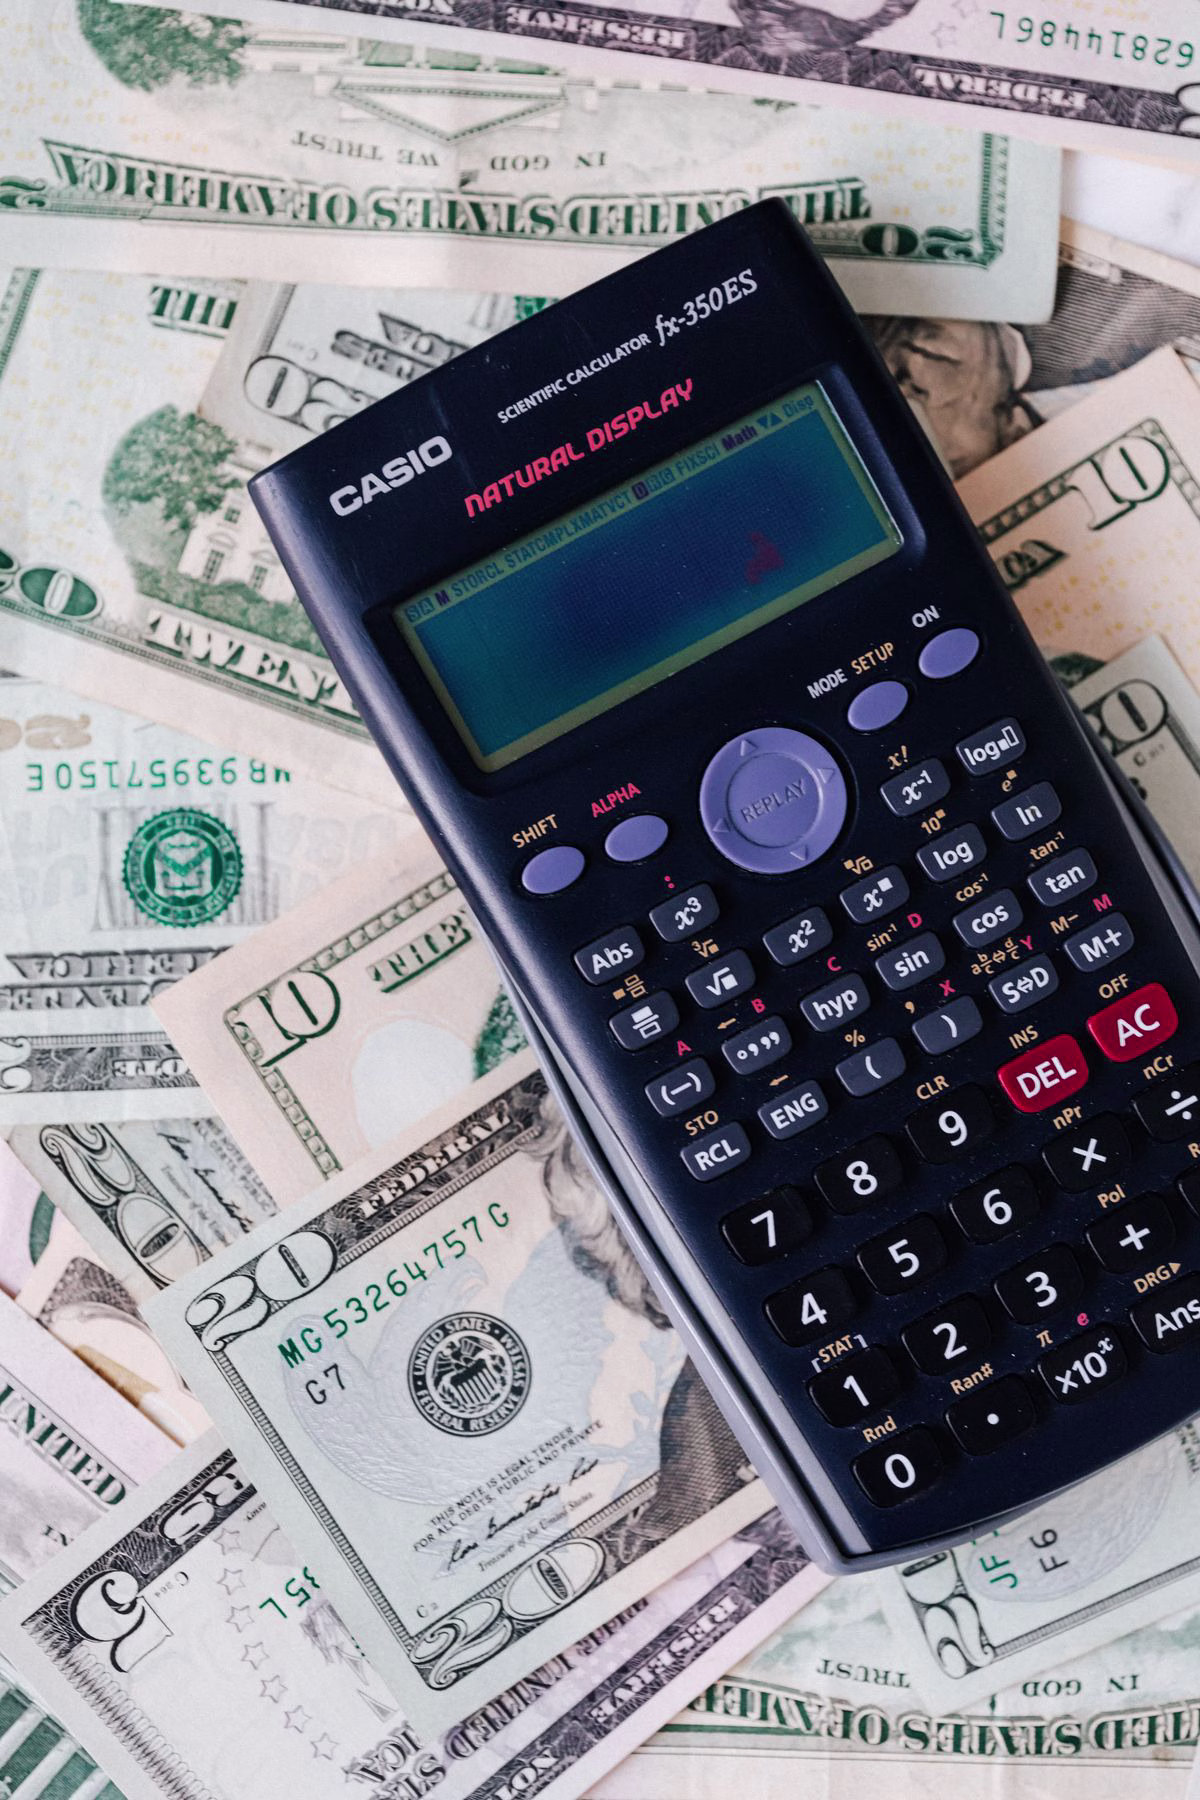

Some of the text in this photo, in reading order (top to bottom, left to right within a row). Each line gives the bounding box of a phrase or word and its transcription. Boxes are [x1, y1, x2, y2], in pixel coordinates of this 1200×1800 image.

[505, 5, 1088, 111] FEDERAL RESERVE
[290, 129, 607, 172] IN GOD WE TRUST
[40, 138, 755, 237] NITED STATES OF AMERICA
[497, 268, 759, 424] SCIENTIFIC CALCULATOR fx-350ES
[720, 424, 759, 452] Math
[781, 393, 815, 419] Disp
[463, 378, 694, 519] NATURAL DISPLAY
[329, 435, 453, 517] CASIO
[1066, 435, 1171, 532] 10
[911, 604, 941, 628] ON
[143, 608, 366, 722] TWENT
[807, 667, 848, 700] MODE
[590, 782, 642, 818] ALPHA
[739, 779, 809, 824] REPLAY
[511, 813, 559, 849] SHIFT
[932, 841, 975, 870] log
[1045, 865, 1087, 894] tan
[906, 913, 923, 929] D
[971, 904, 1010, 934] cos
[1092, 893, 1113, 913] M
[366, 905, 474, 994] THE
[591, 941, 634, 975] Abs
[1018, 935, 1034, 951] Y
[1079, 928, 1123, 963] M+
[826, 956, 843, 972] C
[894, 949, 931, 978] sin
[812, 988, 859, 1021] hyp
[938, 979, 956, 997] X
[1098, 973, 1130, 1000] OFF
[253, 969, 342, 1068] 10
[751, 998, 766, 1014] B
[1007, 1025, 1040, 1050] INS
[1115, 1003, 1161, 1048] AC
[676, 1039, 693, 1057] A
[112, 1057, 190, 1078] OTE
[1015, 1055, 1078, 1100] DEL
[1142, 1054, 1175, 1080] nCr
[915, 1074, 950, 1101] CLR
[684, 1110, 720, 1137] STO
[769, 1091, 820, 1130] ENG
[937, 1110, 969, 1147] 9
[1052, 1104, 1083, 1130] nPr
[358, 1111, 513, 1219] FEDERAL
[693, 1138, 741, 1172] RCL
[845, 1159, 879, 1196] 8
[1096, 1183, 1127, 1209] Pol
[982, 1188, 1013, 1226] 6
[750, 1209, 777, 1248] 7
[887, 1238, 920, 1278] 5
[184, 1229, 340, 1353] 20
[1024, 1270, 1058, 1308] 3
[800, 1291, 828, 1326] 4
[1153, 1298, 1200, 1339] Ans
[412, 1316, 493, 1374] UNITED STATES
[817, 1334, 855, 1364] STAT
[931, 1322, 968, 1361] 2
[416, 1334, 529, 1432] FEDERAL RESERVE SYSTEM
[842, 1374, 871, 1408] 1
[950, 1362, 995, 1395] Ran#
[862, 1415, 898, 1443] Rnd
[413, 1533, 434, 1551] FOR
[437, 1518, 457, 1535] ALL
[497, 1466, 535, 1493] PUBLIC
[537, 1449, 560, 1467] AND
[560, 1420, 603, 1451] PRIVATE
[430, 1427, 573, 1525] THIS NOTE IS LEGAL TENDER
[884, 1453, 917, 1489] 0
[69, 1568, 175, 1674] 5
[408, 1536, 608, 1692] 20
[493, 1592, 739, 1800] RESERVE NOT
[816, 1657, 1141, 1699] IN GOD TRUST
[443, 1652, 578, 1761] UNITED
[822, 1703, 893, 1749] OF
[900, 1710, 1084, 1759] STATES
